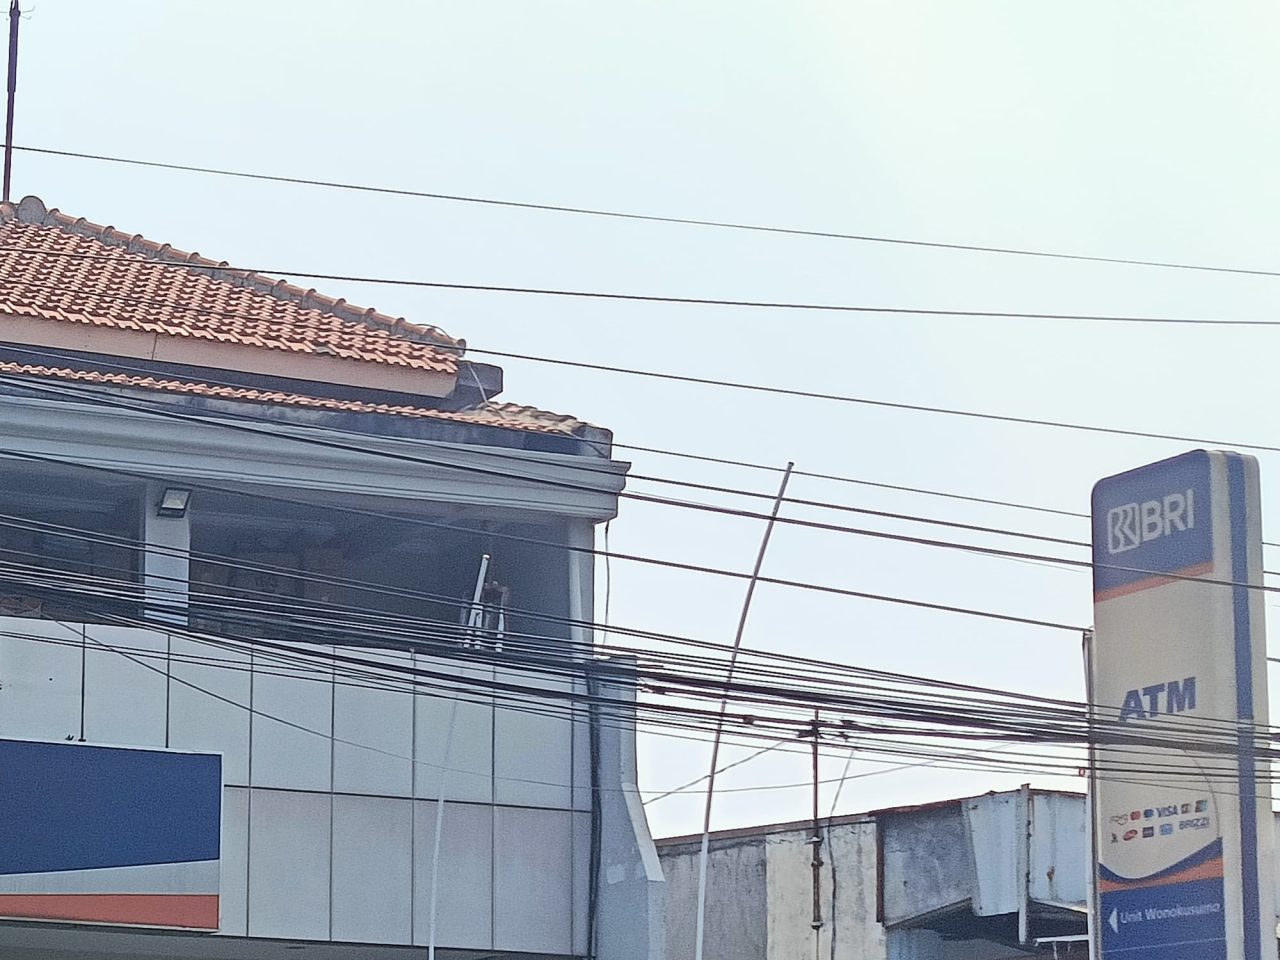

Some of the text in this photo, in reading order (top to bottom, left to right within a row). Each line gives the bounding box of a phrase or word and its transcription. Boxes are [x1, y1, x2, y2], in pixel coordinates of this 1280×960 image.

[1141, 488, 1194, 541] BRI
[1118, 676, 1197, 723] ATM
[1119, 910, 1142, 924] Unit
